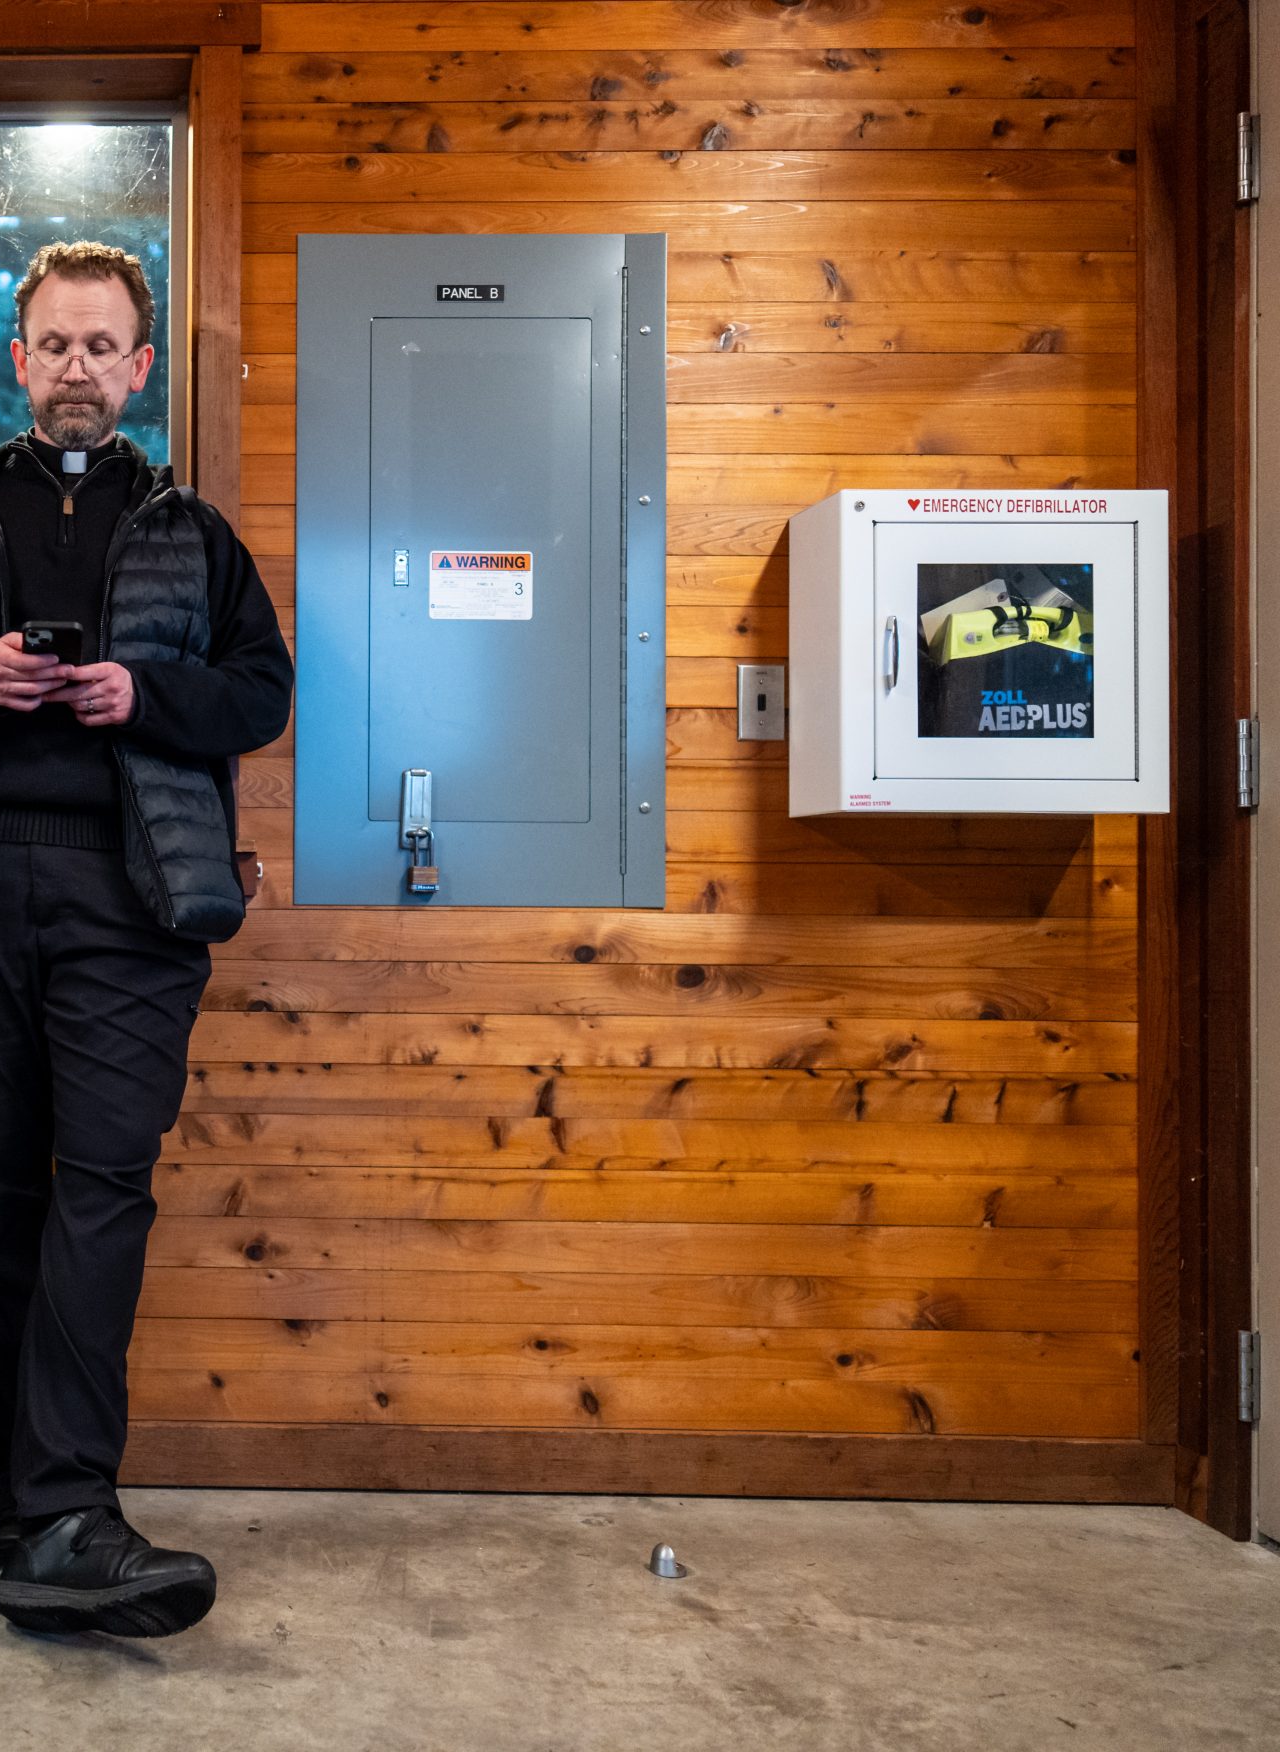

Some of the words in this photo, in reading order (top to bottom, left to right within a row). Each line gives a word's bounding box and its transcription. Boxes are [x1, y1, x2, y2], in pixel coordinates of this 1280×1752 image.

[442, 287, 483, 299] PANEL
[490, 287, 499, 299] B
[923, 498, 1003, 513] EMERGENCY
[1007, 499, 1108, 514] DEFIBRILLATOR
[456, 555, 526, 569] WARNING
[514, 582, 524, 596] 3
[980, 689, 1027, 705] ZOLL
